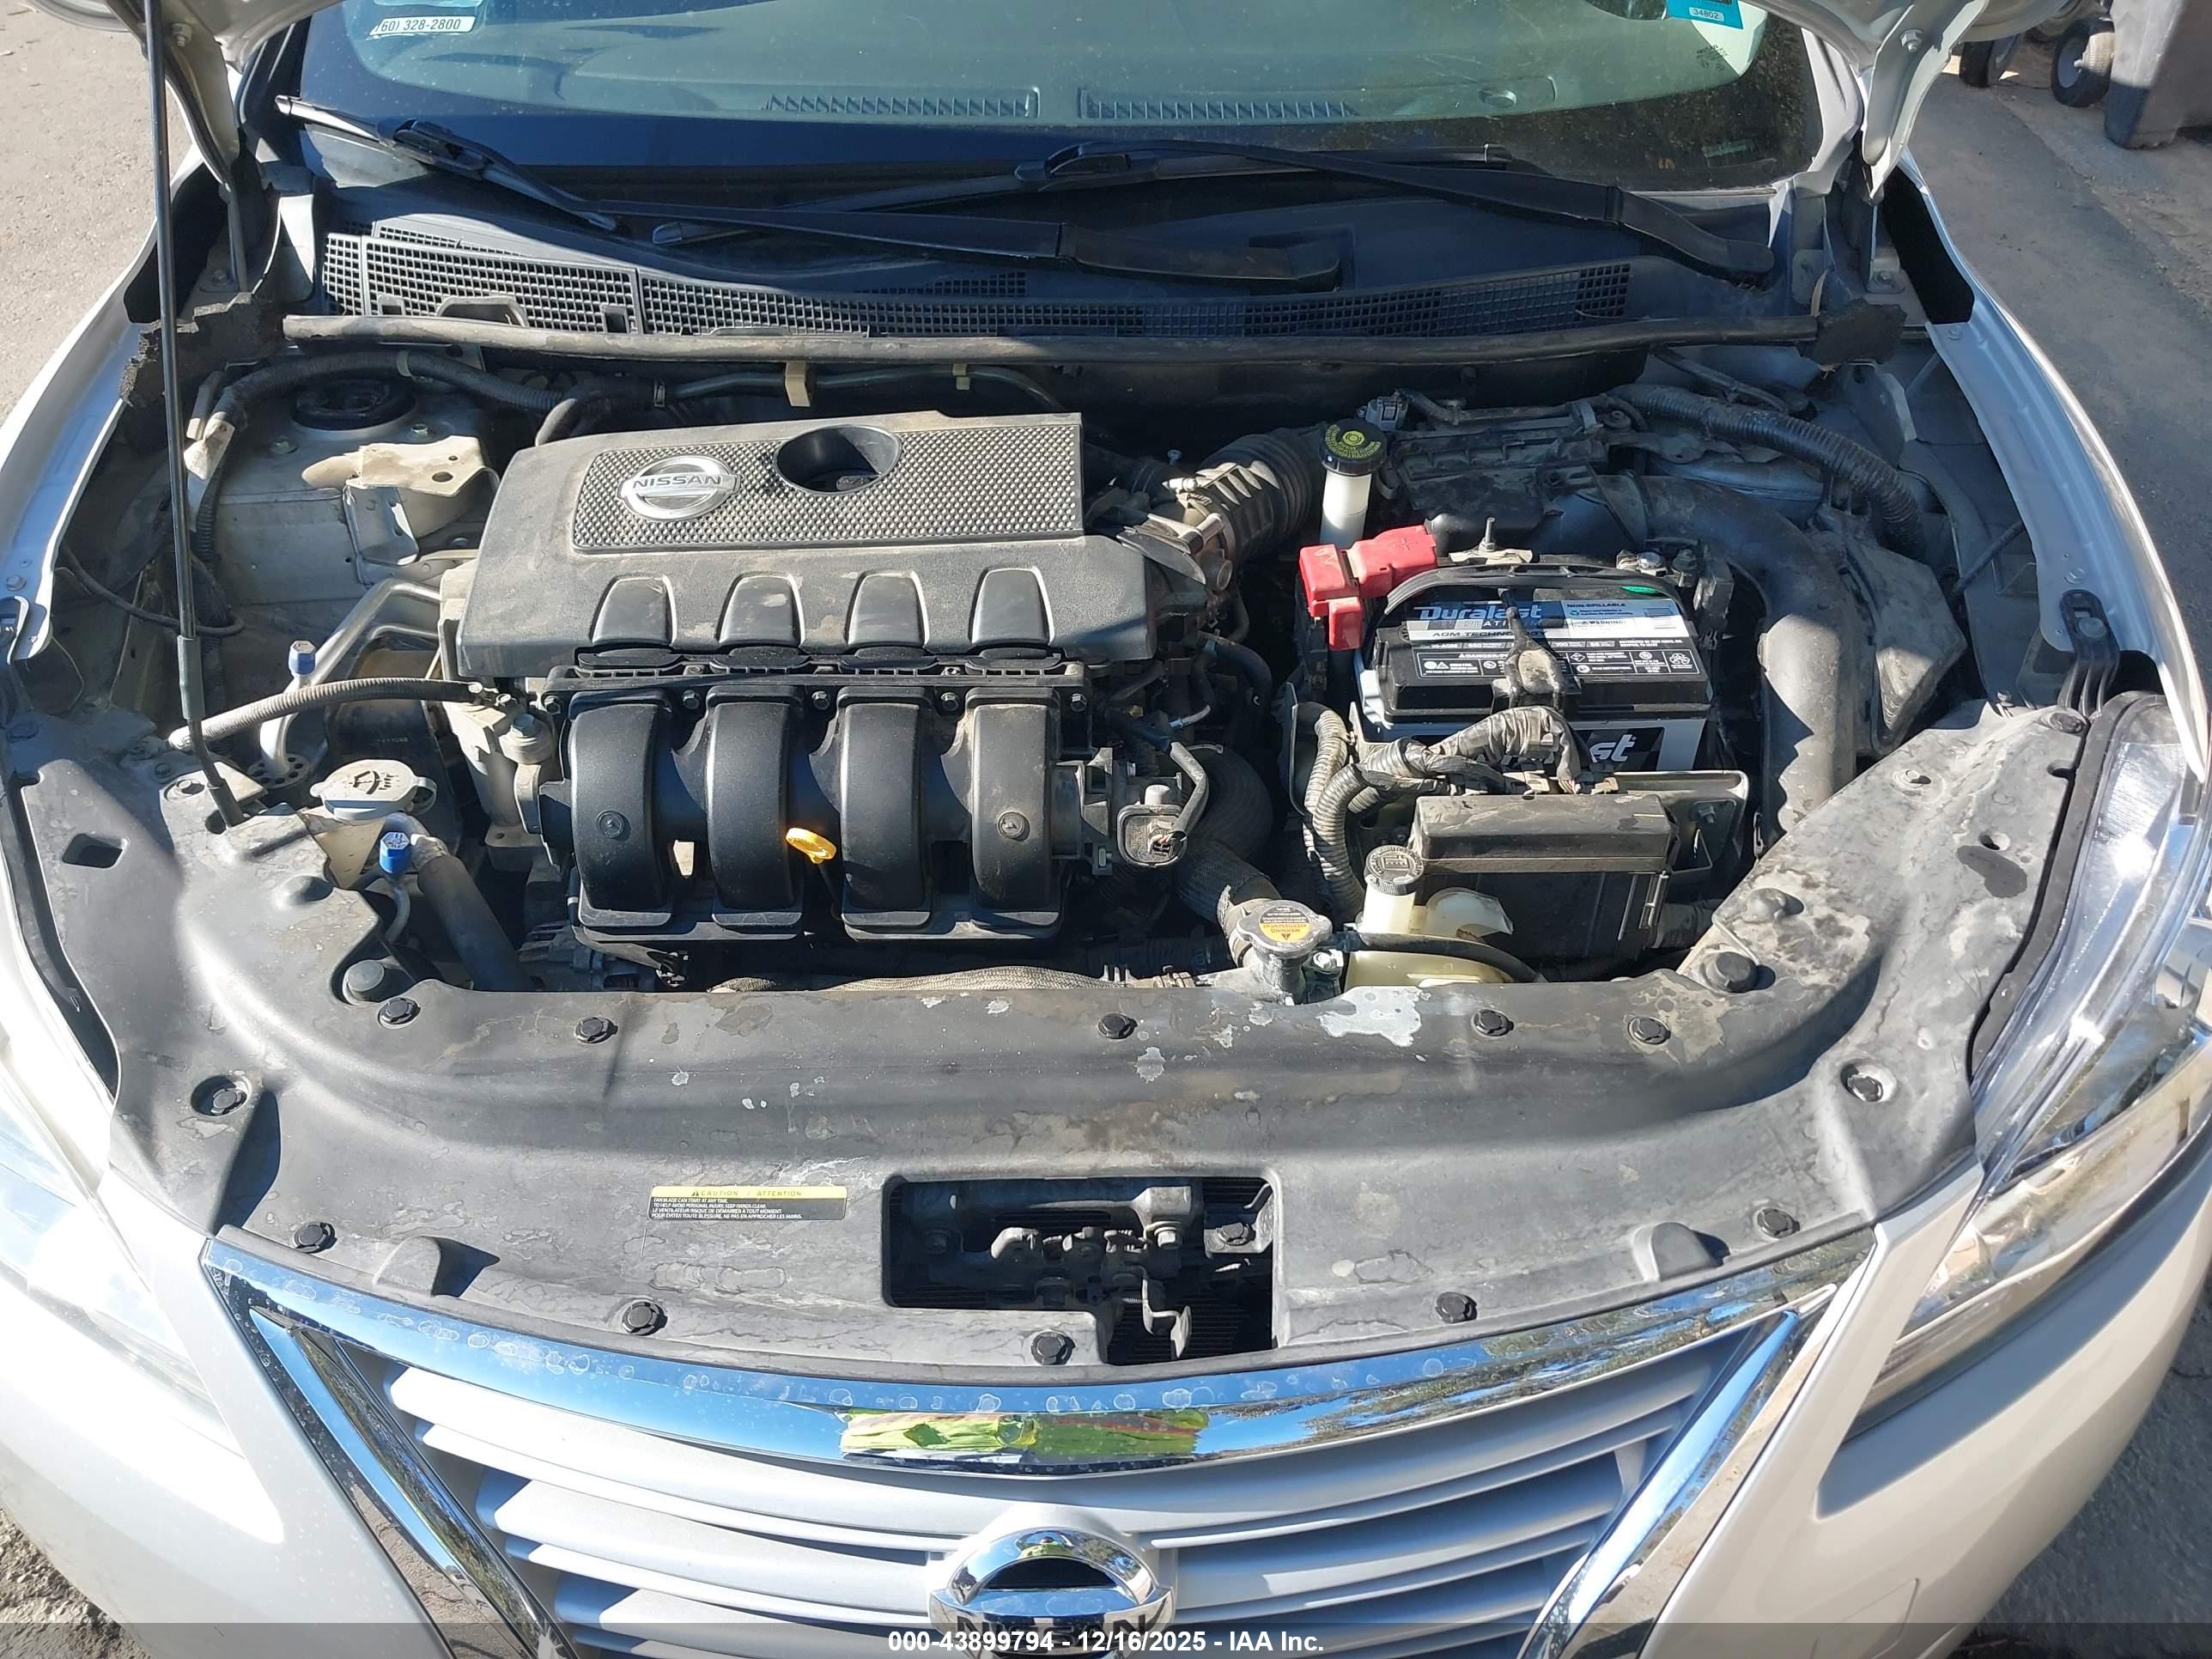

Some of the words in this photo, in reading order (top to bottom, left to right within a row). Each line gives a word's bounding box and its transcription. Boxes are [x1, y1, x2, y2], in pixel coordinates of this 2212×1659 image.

[1692, 8, 1719, 19] 34802
[403, 19, 461, 31] 328-2800
[632, 475, 722, 489] NISSAN
[1413, 605, 1542, 620] Duralast
